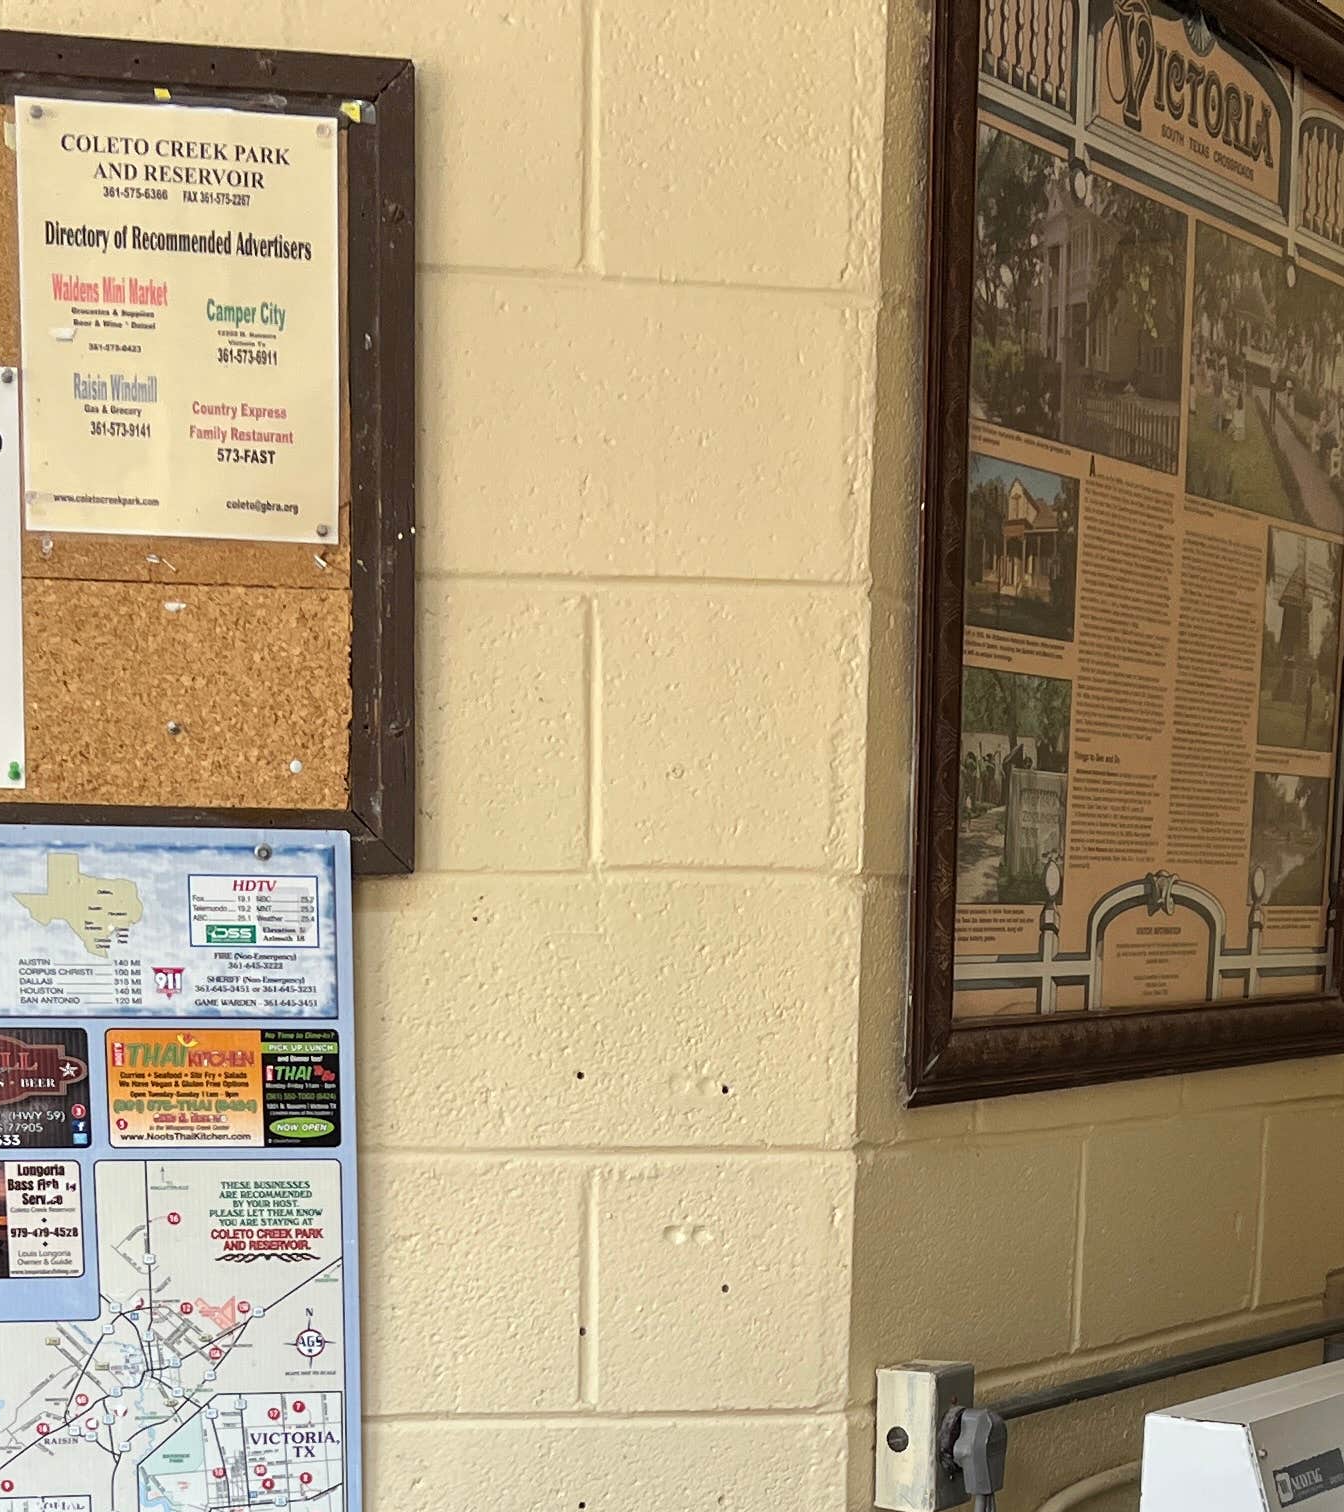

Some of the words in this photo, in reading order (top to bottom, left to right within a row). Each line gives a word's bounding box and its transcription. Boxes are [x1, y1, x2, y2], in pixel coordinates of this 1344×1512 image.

[60, 133, 149, 156] COLETO
[155, 139, 227, 160] CREEK
[234, 144, 290, 165] PARK
[1161, 124, 1184, 144] SOUTH
[1189, 138, 1209, 158] TEXAS
[94, 162, 137, 181] AND
[144, 165, 265, 189] RESERVOIR
[103, 186, 168, 200] 361-575-6366
[183, 190, 197, 203] FAX
[45, 220, 108, 253] Directory
[114, 225, 127, 249] of
[131, 225, 231, 255] Recommended
[236, 231, 311, 261] Advertisers
[51, 273, 99, 302] Waldens
[102, 277, 125, 305] Mini
[129, 279, 168, 306] Market
[206, 298, 256, 328] Camper
[260, 301, 286, 330] City
[73, 372, 107, 401] Raisin
[110, 374, 157, 403] Windmill
[191, 401, 237, 420] Country
[241, 403, 287, 419] Express
[90, 420, 150, 438] 361-573-9141
[189, 424, 227, 443] Family
[230, 427, 293, 445] Restaurant
[217, 448, 276, 464] 573-FAST
[232, 879, 277, 891] HDTV
[155, 972, 181, 990] 911
[125, 1043, 187, 1067] THAI
[20, 1078, 55, 1088] BEER
[276, 1123, 297, 1131] NOW
[302, 1123, 327, 1131] OPEN
[120, 1132, 251, 1141] www.NootsThaiKitchen.com
[17, 1164, 65, 1177] Longoria
[7, 1179, 34, 1191] Bass
[211, 1228, 254, 1239] COLETO
[257, 1229, 292, 1238] CREEK
[295, 1228, 324, 1238] PARK
[223, 1241, 246, 1251] AND
[250, 1431, 340, 1445] VICTORIA,
[293, 1446, 315, 1458] TX
